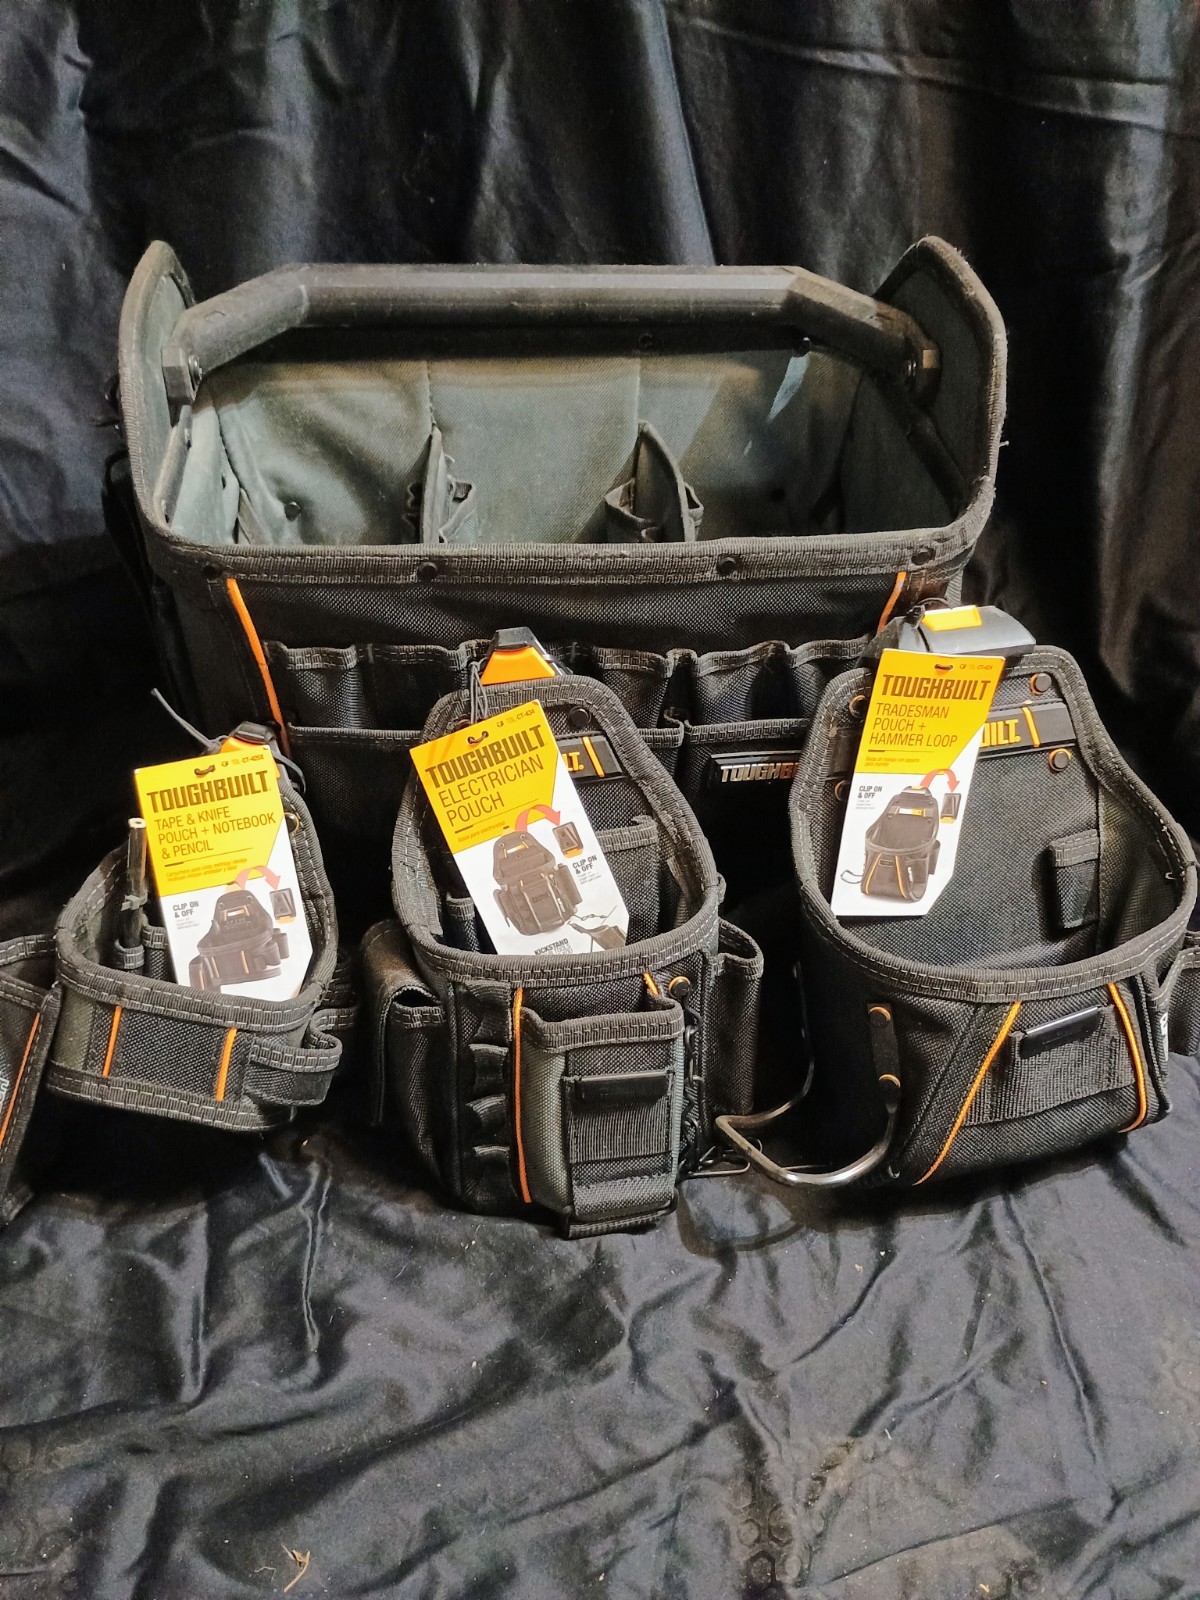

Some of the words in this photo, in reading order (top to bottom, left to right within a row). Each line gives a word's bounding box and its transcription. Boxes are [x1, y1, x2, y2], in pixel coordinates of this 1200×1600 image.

[881, 674, 991, 701] TOUGHBUILT
[876, 702, 950, 719] TRADESMAN
[873, 717, 915, 732] POUCH
[918, 722, 927, 731] +
[869, 732, 923, 747] HAMMER
[926, 734, 958, 748] LOOP
[425, 724, 545, 789] TOUGHBUILT
[146, 770, 269, 814] TOUGHBUILT
[438, 754, 544, 809] ELECTRICIAN
[155, 815, 184, 831] TAPE
[186, 813, 196, 825] &
[197, 806, 231, 823] KNIFE
[446, 791, 505, 827] POUCH
[158, 827, 198, 845] POUCH
[201, 827, 210, 836] +
[213, 812, 276, 835] NOTEBOOK
[161, 848, 171, 860] &
[173, 840, 214, 857] PENCIL
[572, 858, 587, 870] CLIP
[172, 903, 188, 911] CLIP
